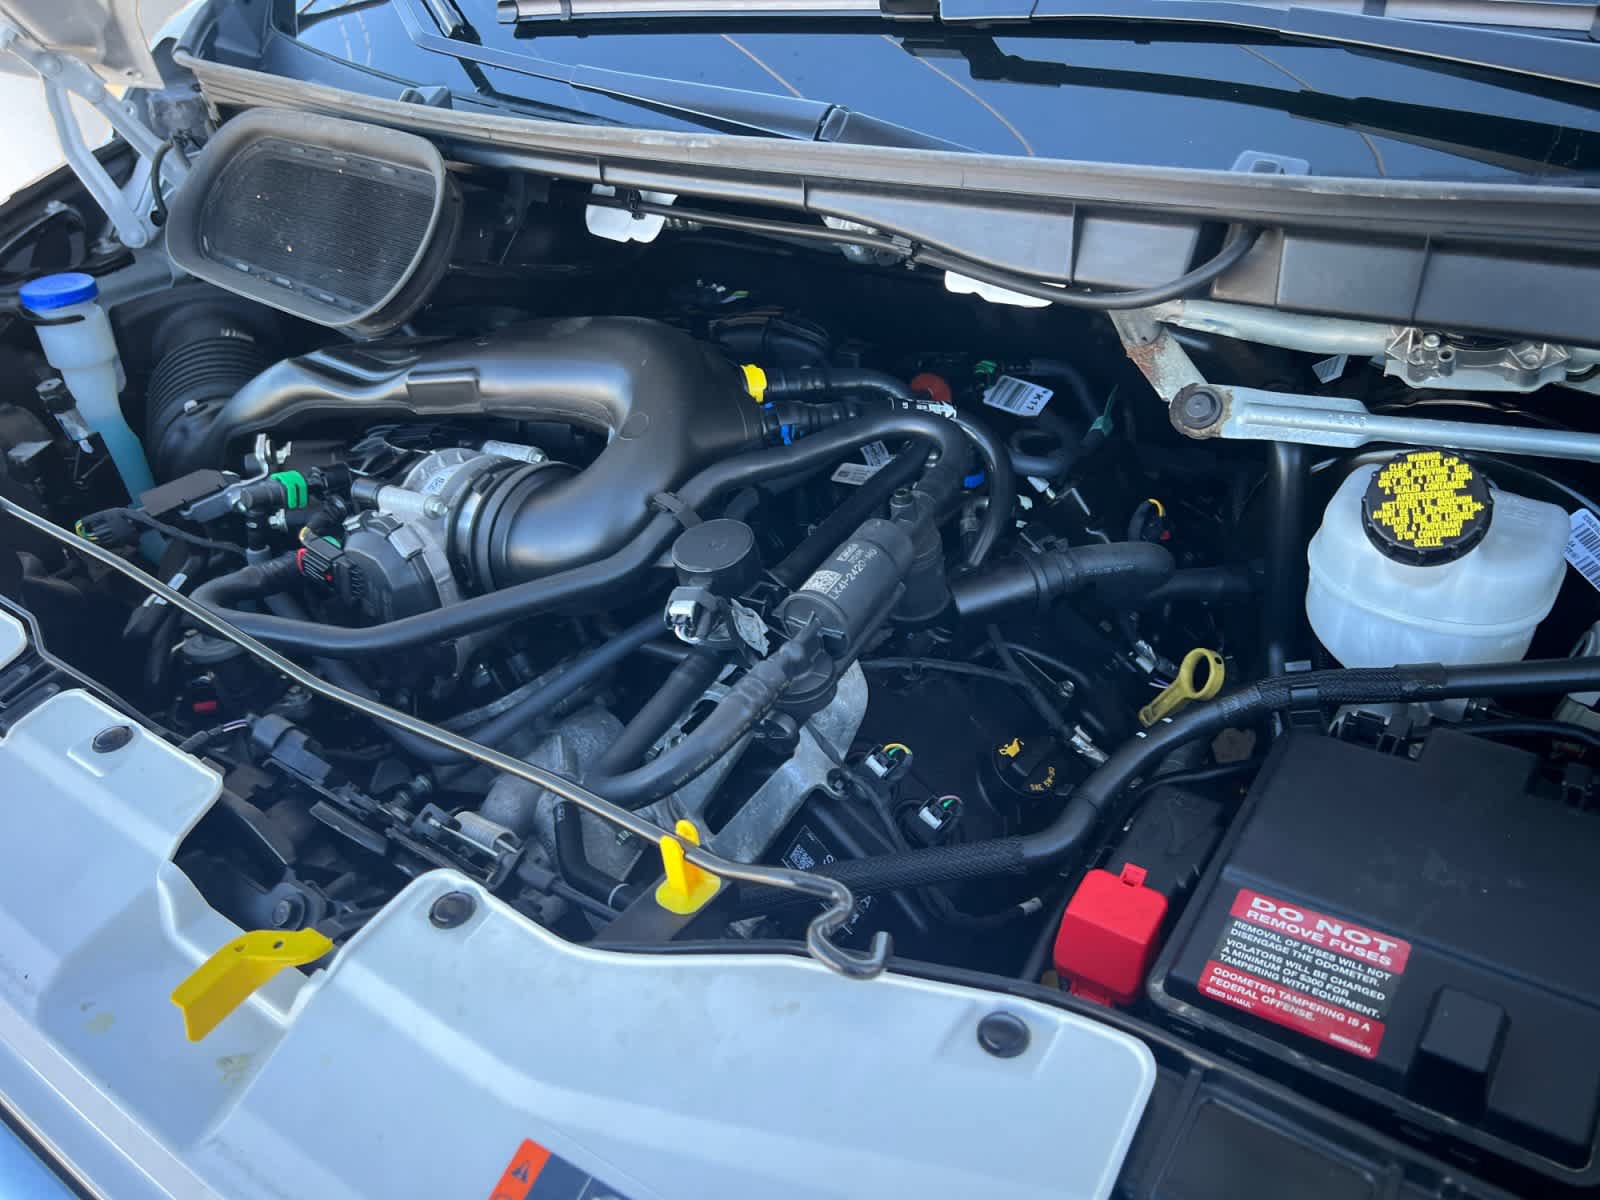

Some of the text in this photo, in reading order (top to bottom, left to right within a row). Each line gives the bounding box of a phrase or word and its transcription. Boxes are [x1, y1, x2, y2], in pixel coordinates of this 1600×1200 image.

[1378, 477, 1397, 488] ONLY
[1400, 475, 1413, 485] DOT
[1427, 473, 1447, 484] FLUID
[1451, 471, 1472, 481] FROM
[1381, 470, 1408, 481] BEFORE
[1455, 464, 1470, 473] USE
[1384, 487, 1391, 496] A
[1394, 484, 1421, 494] SEALED
[1389, 457, 1459, 472] CLEAN FILLER CAP
[1233, 920, 1392, 981] REMOVAL OF FUSES WILL NOT
[1246, 910, 1393, 967] REMOVE FUSES
[1251, 896, 1398, 953] DO NOT
[1218, 954, 1381, 1018] TAMPERING WITH EQUIPMENT.
[1221, 946, 1350, 997] A MINIMUM OF $300 FOR
[1226, 938, 1385, 1001] VIOLATORS WILL BE CHARGED
[1230, 929, 1381, 987] DISENGAGE THE ODOMETER.
[1209, 976, 1316, 1022] FEDERAL OFFENSE.
[1213, 967, 1371, 1032] ODOMETER TAMPERING IS A
